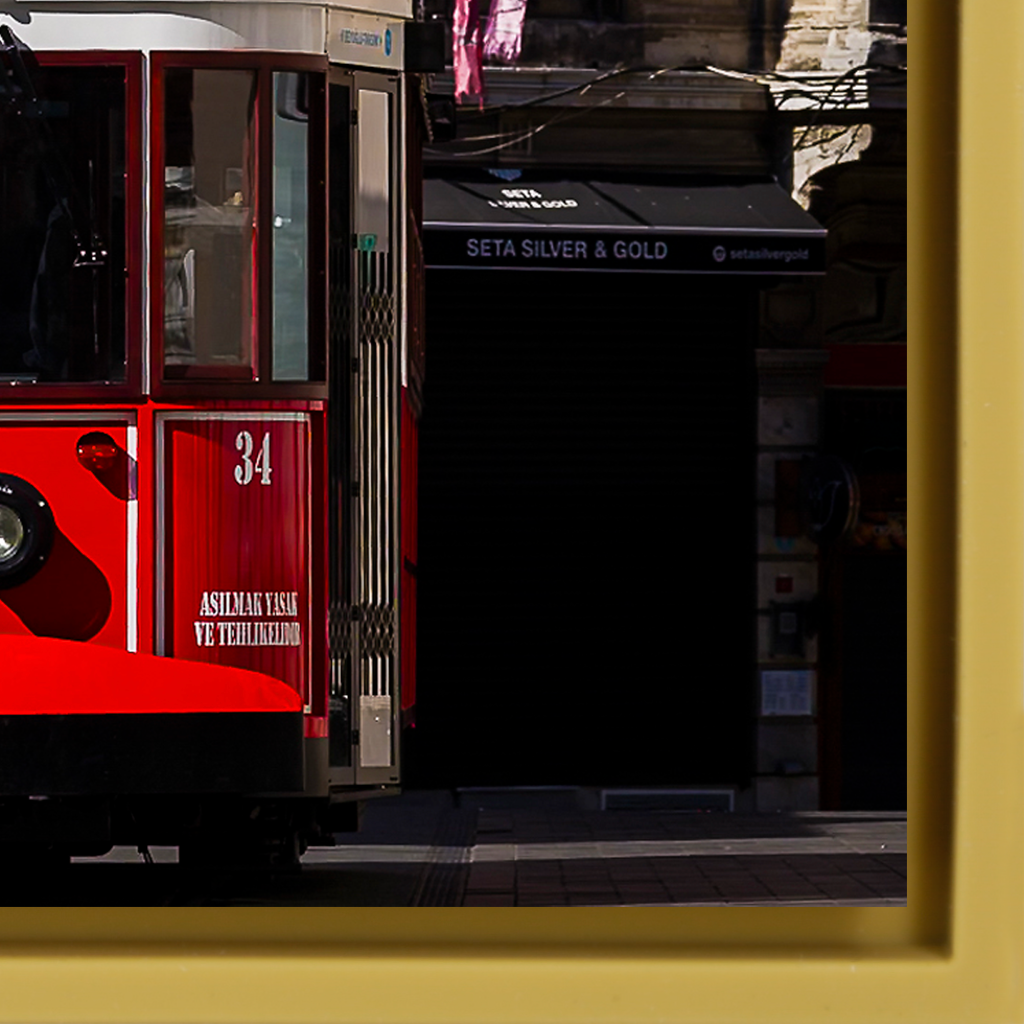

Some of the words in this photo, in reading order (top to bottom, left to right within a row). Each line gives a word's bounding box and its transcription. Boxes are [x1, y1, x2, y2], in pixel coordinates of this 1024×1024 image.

[501, 189, 542, 199] SETA
[541, 199, 578, 209] GOLD
[466, 238, 516, 257] SETA
[521, 239, 588, 259] SILVER
[593, 240, 608, 259] &
[613, 240, 668, 260] GOLD
[729, 248, 810, 263] setasilvergold
[234, 430, 273, 485] 34
[199, 591, 263, 617] ASILMAK
[194, 621, 214, 646] VE
